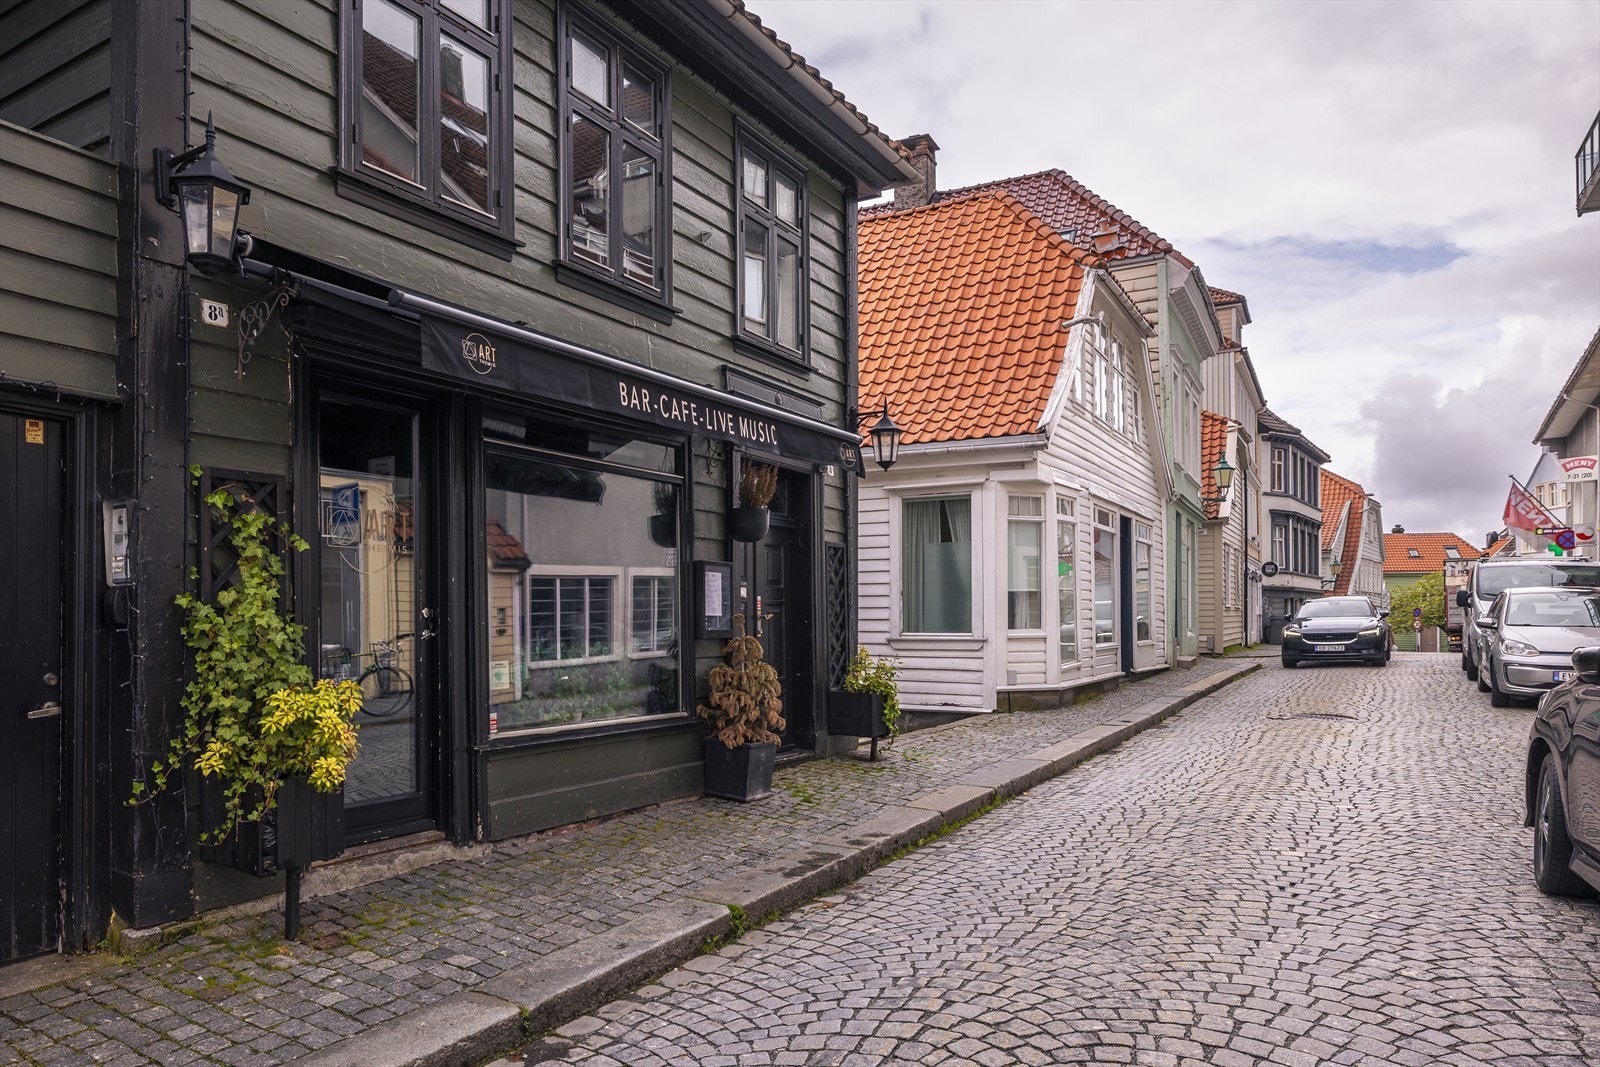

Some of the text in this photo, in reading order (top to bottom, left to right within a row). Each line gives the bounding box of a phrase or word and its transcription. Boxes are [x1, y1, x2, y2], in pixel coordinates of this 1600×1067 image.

[208, 304, 224, 321] 8a
[478, 343, 497, 363] ART
[738, 416, 778, 446] MUSIC
[1565, 459, 1594, 470] MENY
[364, 508, 410, 543] ART
